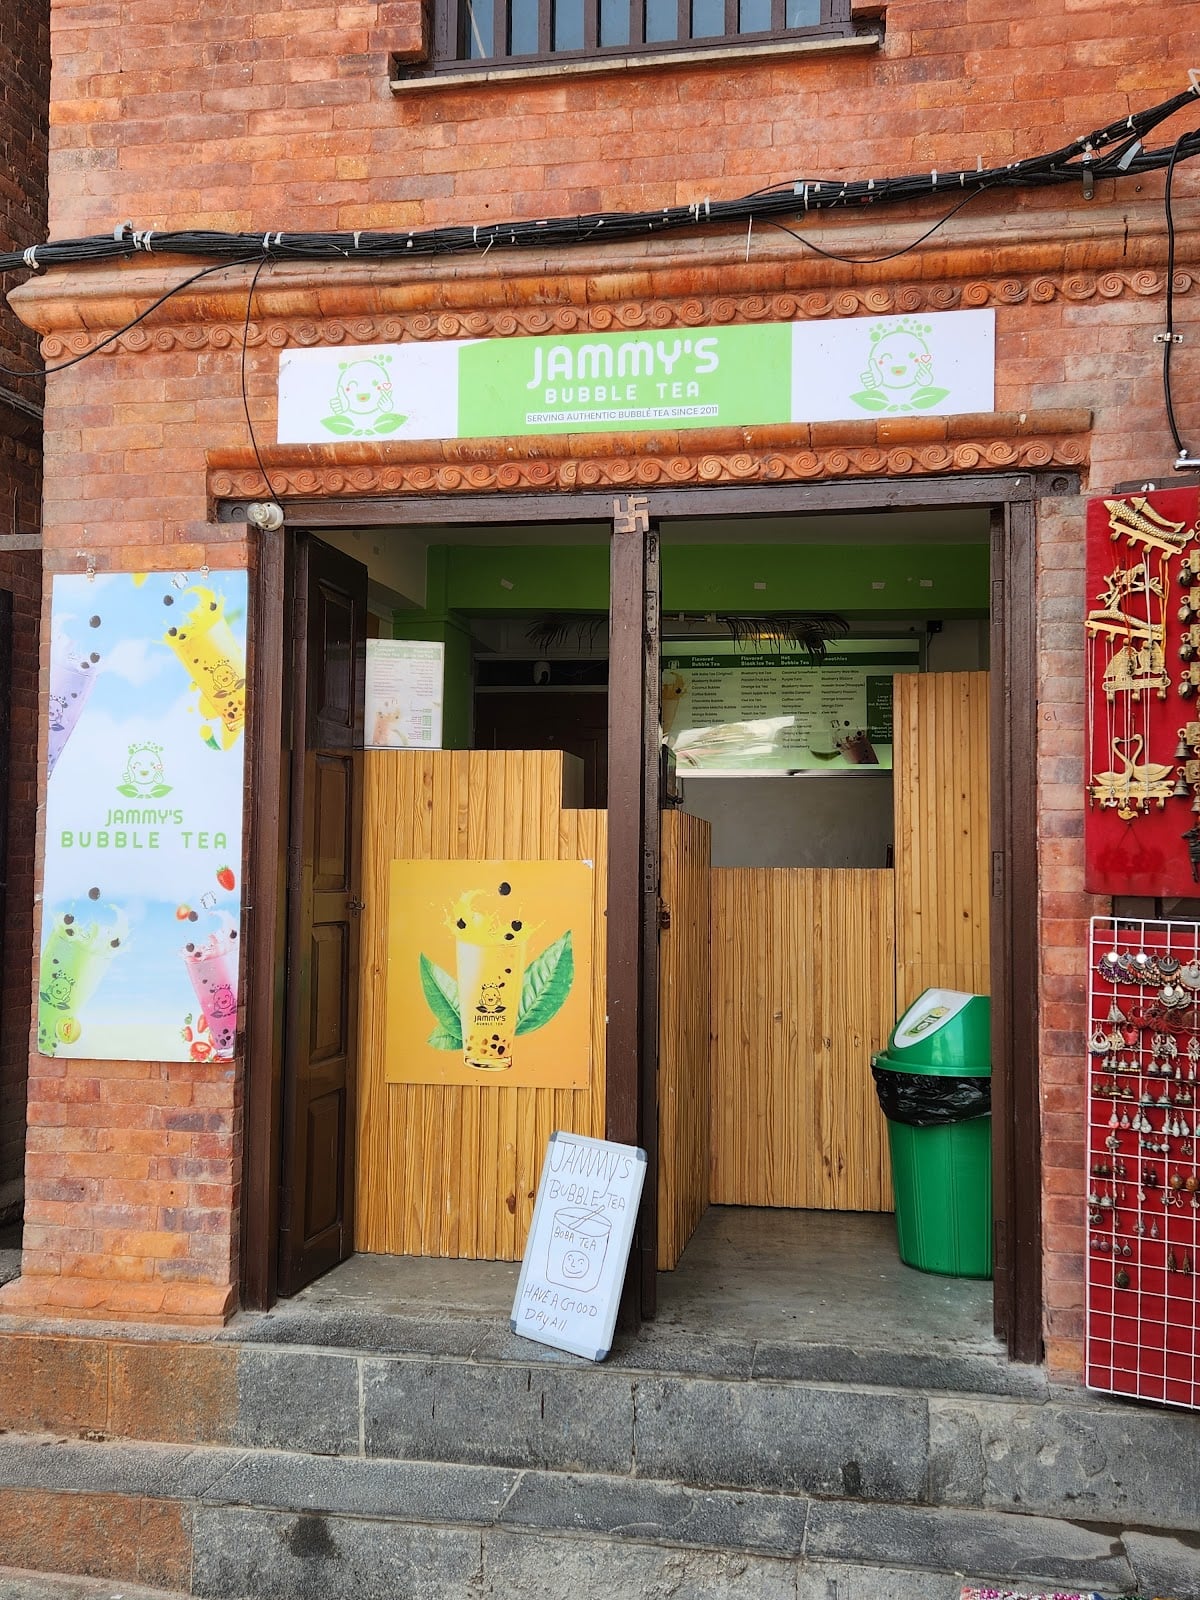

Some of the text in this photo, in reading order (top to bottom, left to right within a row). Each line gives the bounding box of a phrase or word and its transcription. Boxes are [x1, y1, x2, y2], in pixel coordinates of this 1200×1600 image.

[526, 337, 720, 389] JAMMY'S
[545, 381, 700, 404] BUBBLE TEA
[527, 406, 719, 423] SERVING AUTHENTIC BUBBLE TEA SINCE 2011
[104, 808, 184, 828] JAMMY'S
[61, 830, 228, 849] BUBBLE TEA
[473, 1015, 507, 1023] JAMMY'S
[549, 1178, 626, 1211] BUBBLE TEA
[553, 1225, 597, 1251] BOBA TEA
[523, 1283, 598, 1317] HAVE A GOOD
